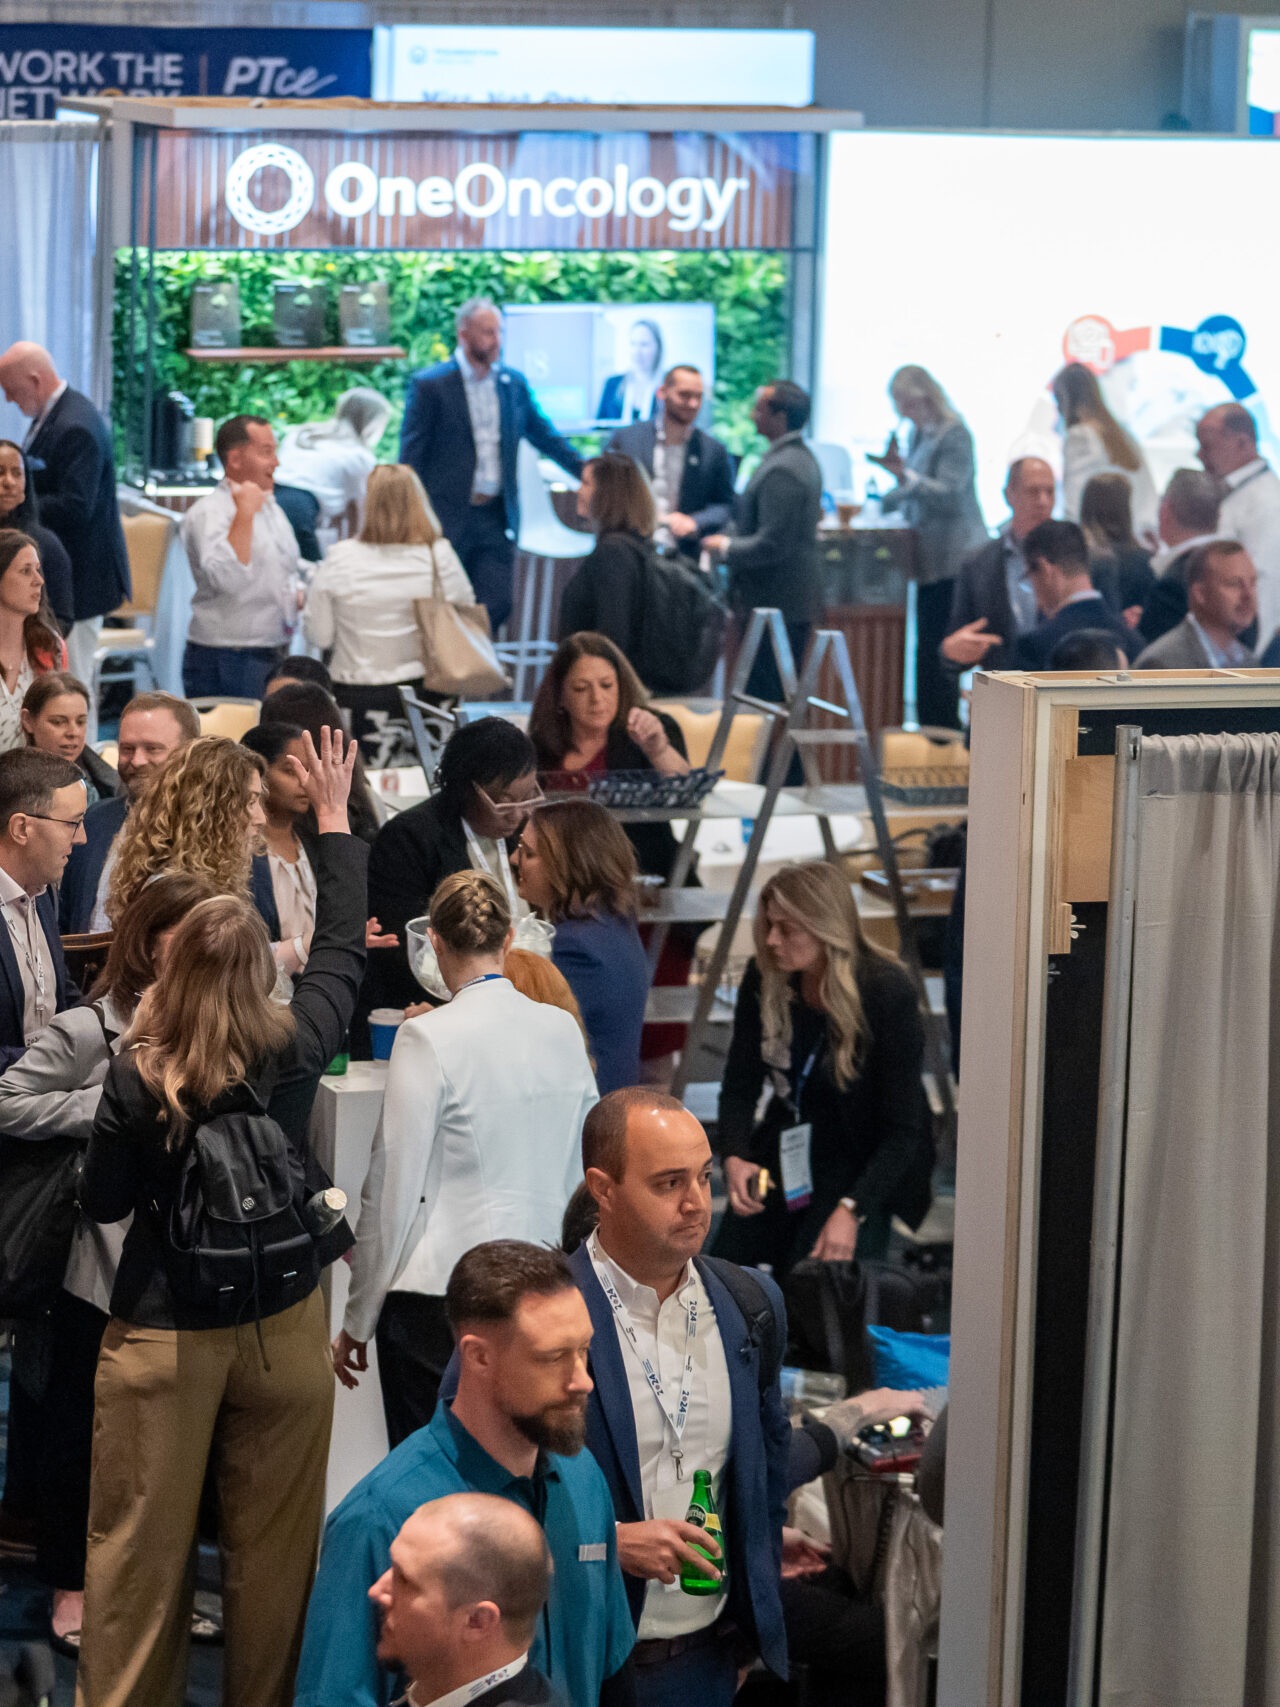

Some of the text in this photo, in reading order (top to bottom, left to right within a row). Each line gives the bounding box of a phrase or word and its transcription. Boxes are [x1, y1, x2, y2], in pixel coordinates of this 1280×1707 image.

[111, 53, 184, 86] THE
[324, 161, 738, 232] OneOncology
[607, 1288, 622, 1311] 2024
[689, 1300, 698, 1322] 2024
[649, 1373, 664, 1396] 2024
[679, 1389, 690, 1413] 2024
